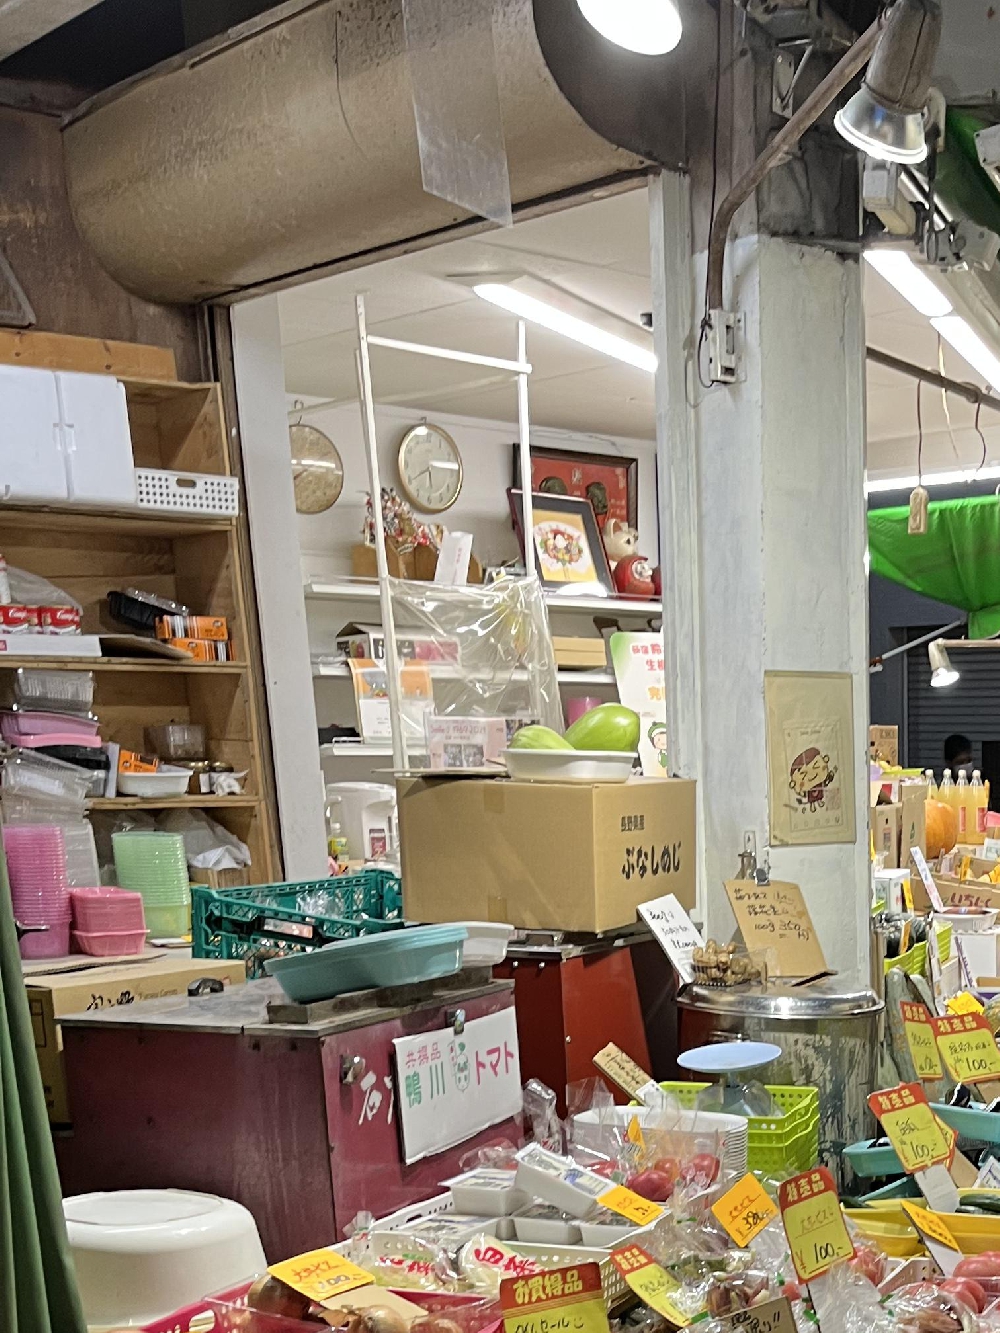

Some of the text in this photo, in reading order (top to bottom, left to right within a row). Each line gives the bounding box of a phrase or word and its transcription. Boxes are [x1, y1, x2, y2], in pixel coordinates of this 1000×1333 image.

[621, 840, 682, 880] ぶなしめじ
[475, 1041, 515, 1086] トマト
[786, 1172, 825, 1202] 特売品
[513, 1269, 583, 1304] お買得品
